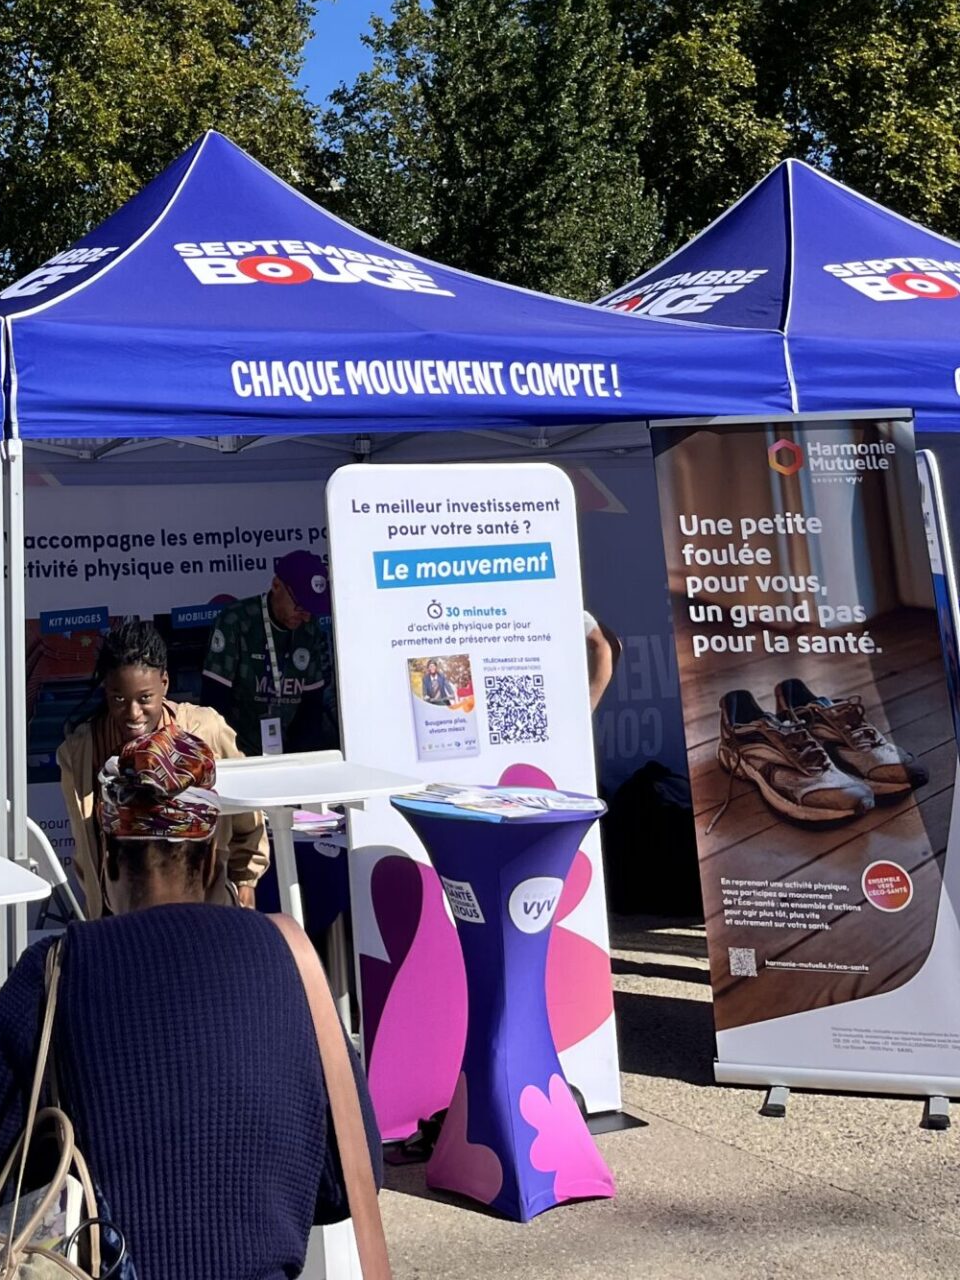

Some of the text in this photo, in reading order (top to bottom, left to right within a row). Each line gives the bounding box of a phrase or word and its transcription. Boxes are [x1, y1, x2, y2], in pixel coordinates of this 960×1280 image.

[174, 241, 427, 275] SEPTEMBRE
[183, 256, 456, 297] BOUGE
[231, 360, 622, 402] CHAQUE MOUVEMENT COMPTE !
[807, 440, 896, 456] Harmonie
[809, 455, 890, 471] Mutuelle
[352, 498, 560, 513] Le meilleur investissement
[389, 520, 531, 539] pour votre santé ?
[680, 513, 822, 540] Une petite
[24, 532, 155, 552] accompagne
[161, 529, 187, 546] les
[193, 527, 303, 548] employeurs
[682, 544, 771, 565] foulée
[85, 558, 174, 581] physique
[180, 563, 203, 573] en
[209, 554, 267, 572] milieu
[383, 552, 548, 580] Le mouvement
[686, 575, 827, 598] pour vous,
[49, 613, 101, 627] KIT NUDGES
[445, 606, 507, 617] 30 minutes
[689, 600, 866, 627] un grand pas
[408, 620, 531, 633] d'activité physique par jour
[391, 632, 552, 648] permettent de préserver votre santé
[693, 630, 883, 657] pour la santé.
[721, 877, 730, 885] En
[732, 879, 768, 887] reprenant
[785, 881, 812, 889] activité
[740, 889, 777, 898] participez
[789, 891, 832, 900] mouvement
[523, 896, 555, 919] vyv
[724, 908, 740, 916] pour
[743, 909, 757, 918] agir
[759, 909, 774, 917] plus
[790, 911, 804, 919] plus
[791, 901, 826, 910] ensemble
[734, 919, 772, 927] autrement
[787, 921, 806, 929] votre
